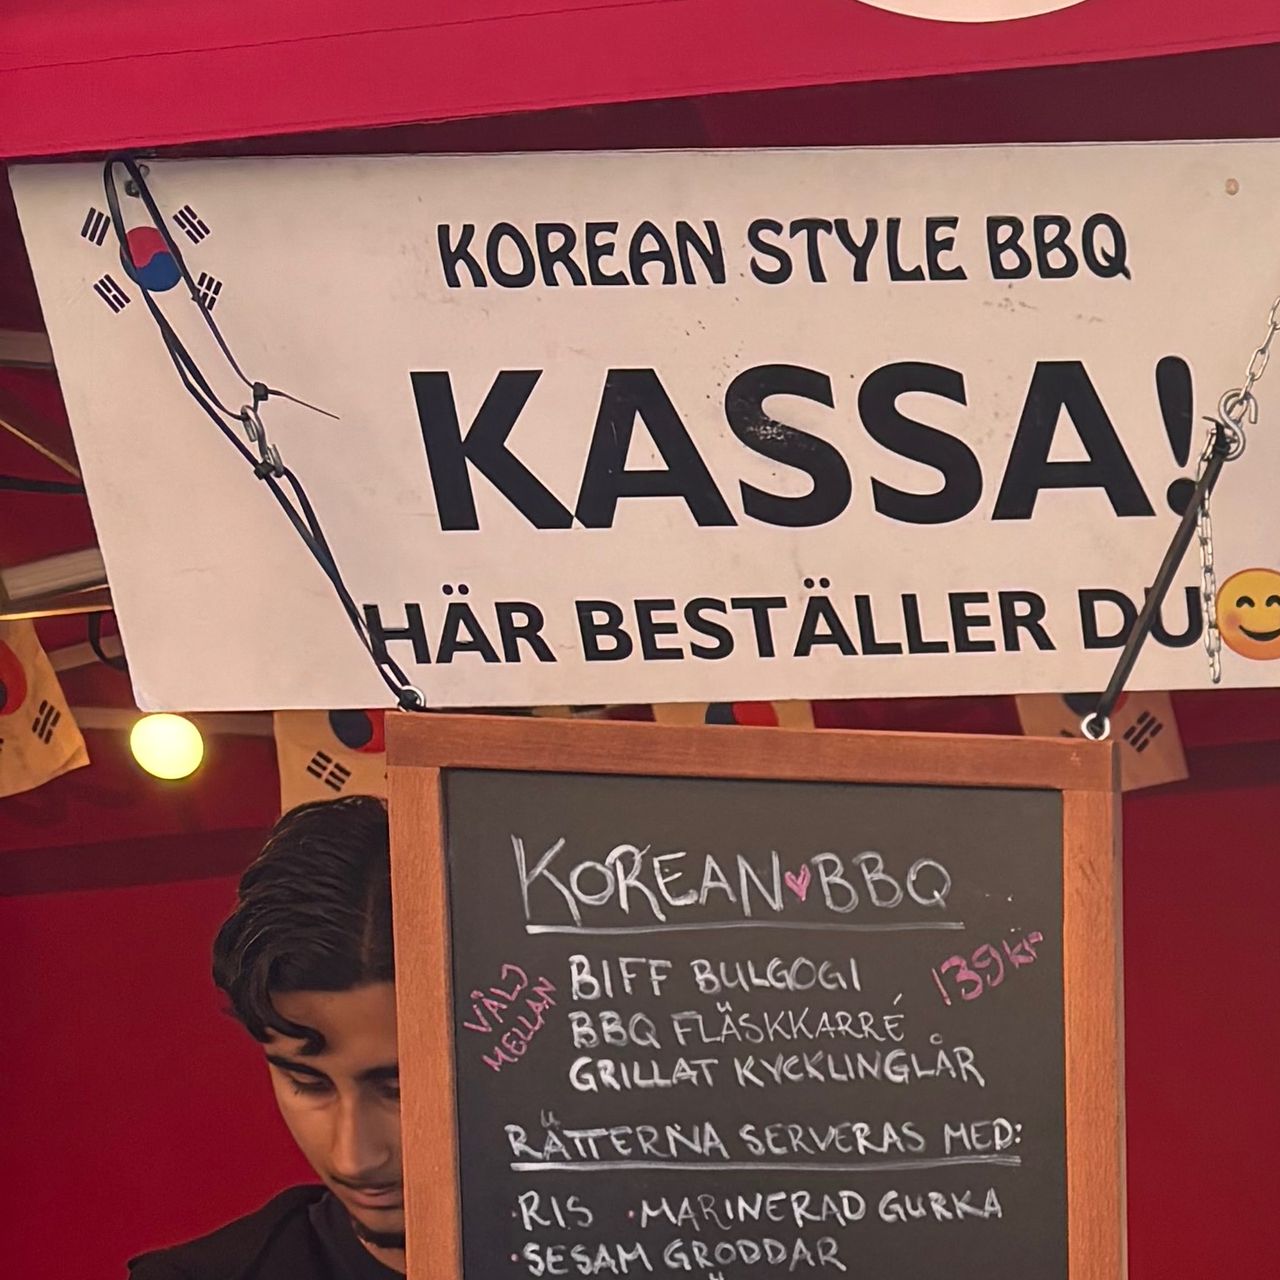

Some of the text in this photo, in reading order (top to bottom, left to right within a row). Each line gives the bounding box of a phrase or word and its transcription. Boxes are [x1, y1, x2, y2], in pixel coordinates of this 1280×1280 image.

[438, 212, 1132, 289] KOREAN STYLE BBQ
[409, 356, 1198, 532] KASSA!
[363, 577, 1202, 664] HÄR BESTÄLLER DU
[511, 835, 952, 924] KOREAN BBQ
[568, 955, 861, 1001] BIFF BULGOGI
[481, 976, 557, 1073] MELLAN
[568, 993, 905, 1049] BBQ FLÄSKKARRÉ
[568, 1033, 986, 1092] GRILLAT KYCKLINGLÅR
[504, 1109, 1023, 1160] RÄTTERNA SERVERAS MED:
[518, 1190, 593, 1231] RIS
[641, 1187, 1003, 1231] MARINERAD GURKA
[523, 1238, 847, 1277] SESAM GRODDAR
